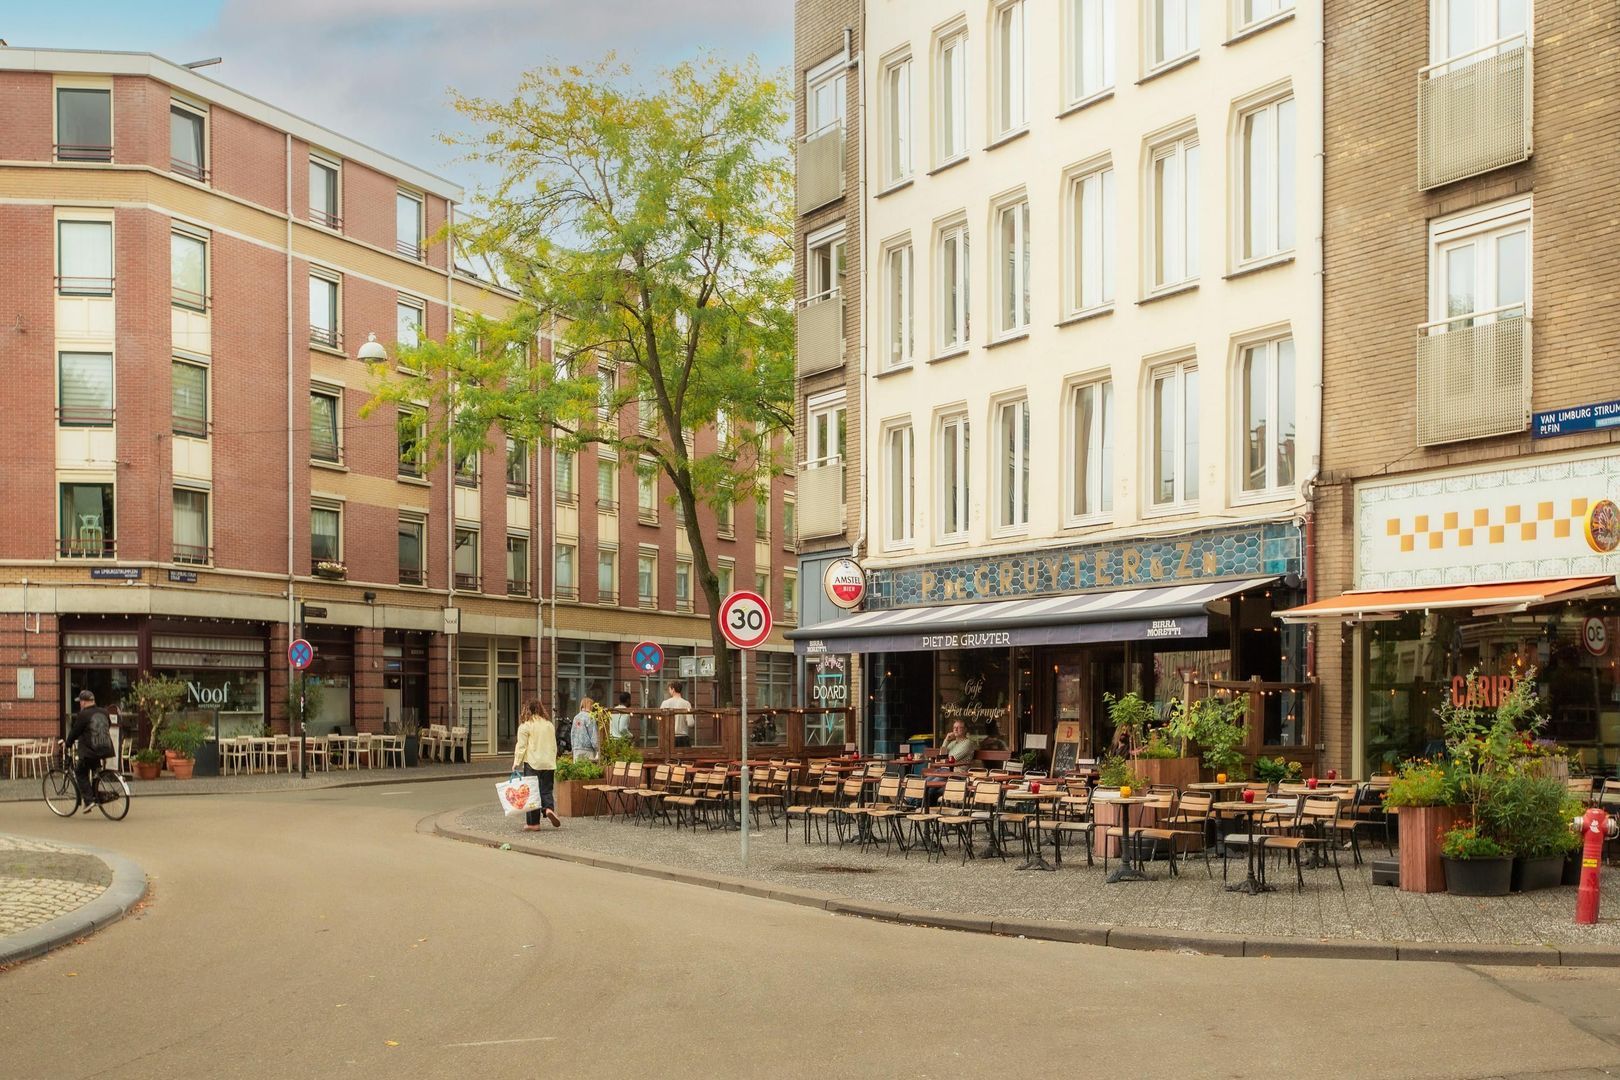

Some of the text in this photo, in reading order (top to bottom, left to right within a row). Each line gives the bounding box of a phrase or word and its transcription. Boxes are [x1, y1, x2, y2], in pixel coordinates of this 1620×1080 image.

[1540, 414, 1556, 425] VAN
[1558, 408, 1591, 422] LIMBURG
[975, 548, 1140, 595] GRUYTER
[1150, 556, 1164, 579] &
[834, 576, 861, 585] AMSTEL
[730, 609, 763, 630] 30
[1152, 619, 1176, 629] BIRRA
[922, 632, 1011, 648] PIET DE GRUYTER
[1147, 627, 1181, 637] MORETTI
[187, 681, 231, 703] Noof
